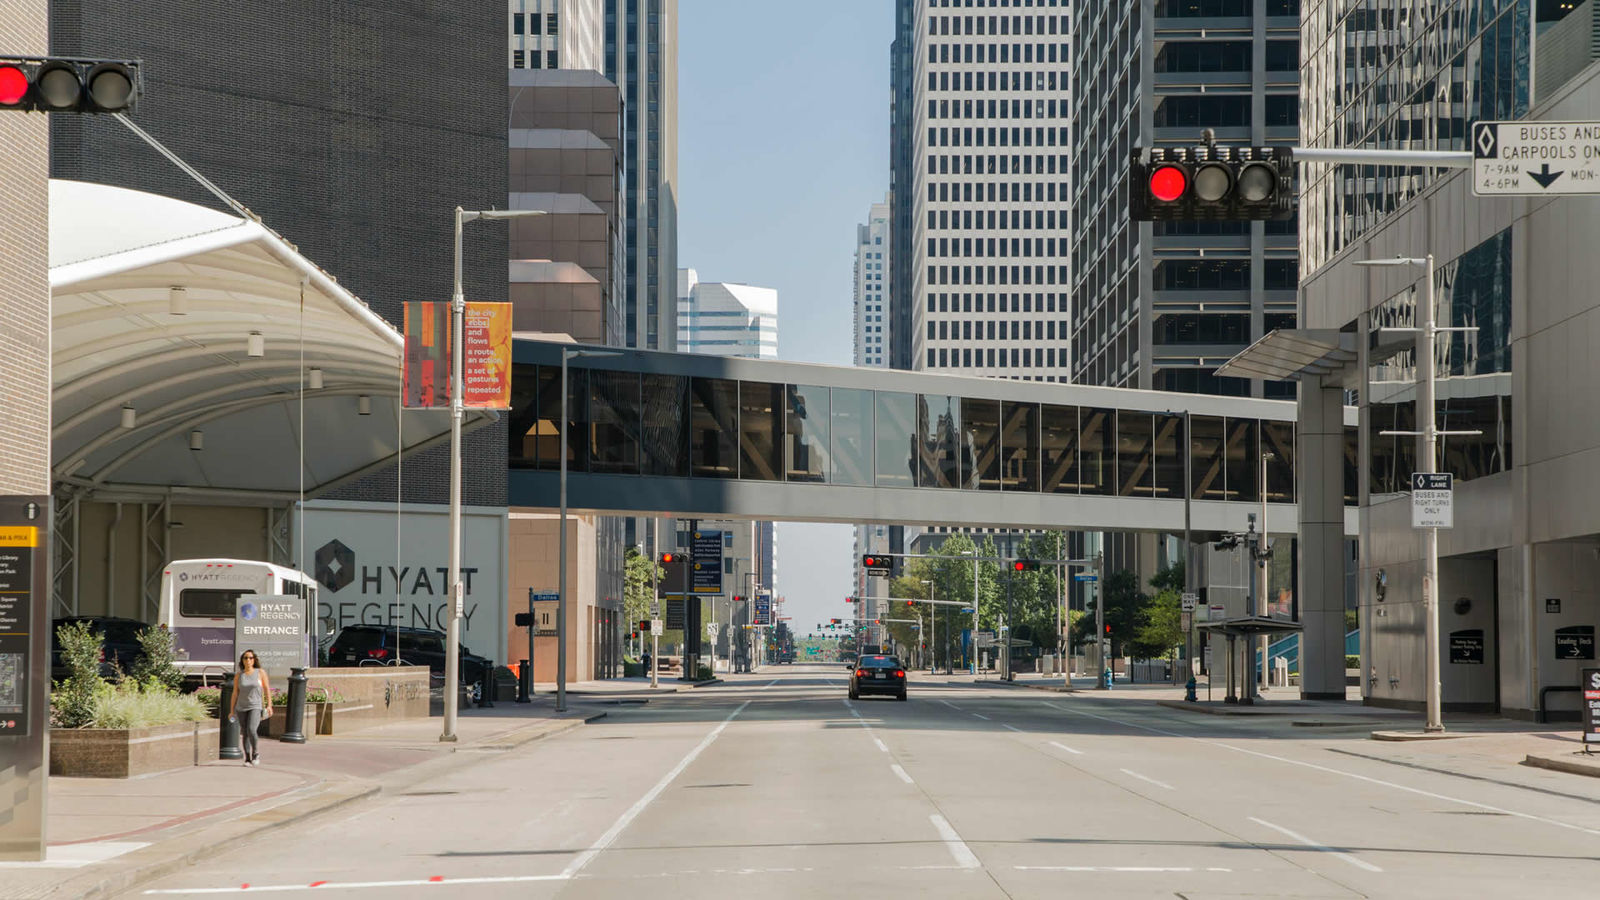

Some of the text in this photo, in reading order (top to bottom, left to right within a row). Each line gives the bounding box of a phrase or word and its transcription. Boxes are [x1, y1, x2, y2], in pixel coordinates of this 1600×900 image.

[1520, 126, 1600, 141] BUSES AND
[1502, 145, 1576, 160] CARPOOLS
[1483, 164, 1520, 175] 7-9AM
[1483, 178, 1520, 189] 4-6PM
[468, 309, 497, 318] the city
[487, 367, 496, 375] of
[468, 376, 499, 384] gestures
[1415, 491, 1450, 499] BUSES AND
[361, 566, 478, 595] HYATT
[260, 604, 292, 612] HYATT
[260, 612, 301, 620] REGENCY
[243, 626, 300, 635] ENTRANCE
[201, 637, 234, 646] hyatt.com
[1557, 637, 1578, 646] Loading
